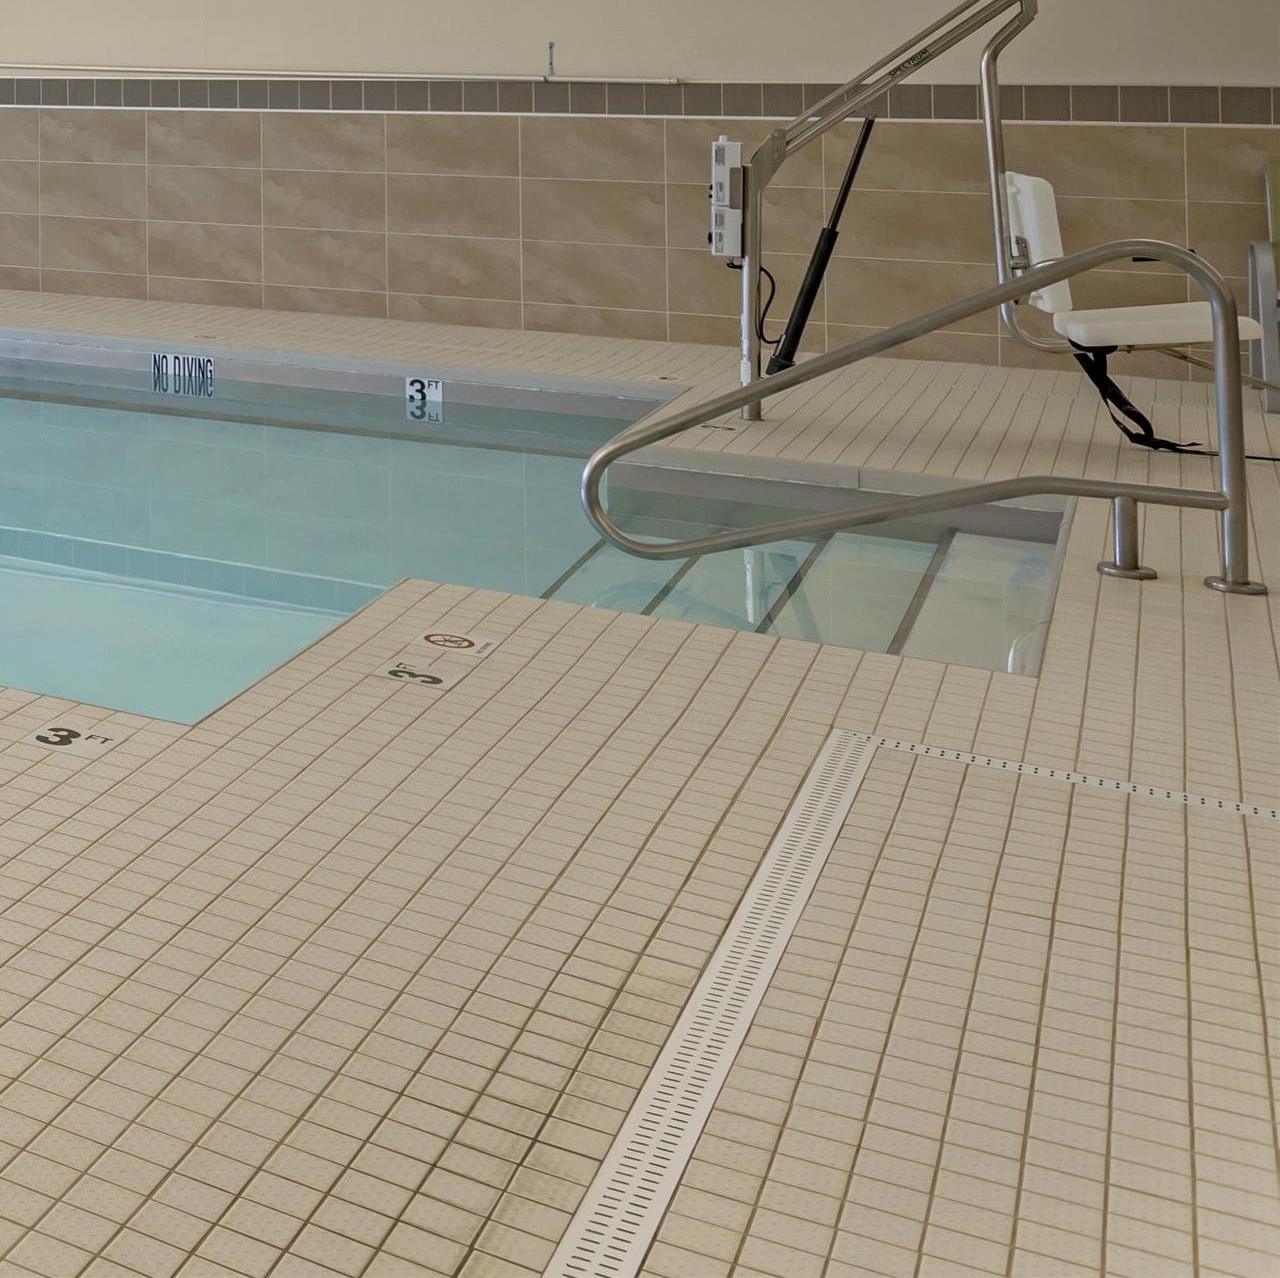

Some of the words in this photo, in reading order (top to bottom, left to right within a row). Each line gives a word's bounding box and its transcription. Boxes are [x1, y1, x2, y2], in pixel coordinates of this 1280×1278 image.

[153, 353, 168, 375] NO
[173, 355, 213, 379] DIVING
[409, 378, 427, 401] 3
[427, 380, 440, 390] FT
[35, 727, 82, 746] 3
[84, 734, 115, 745] FT
